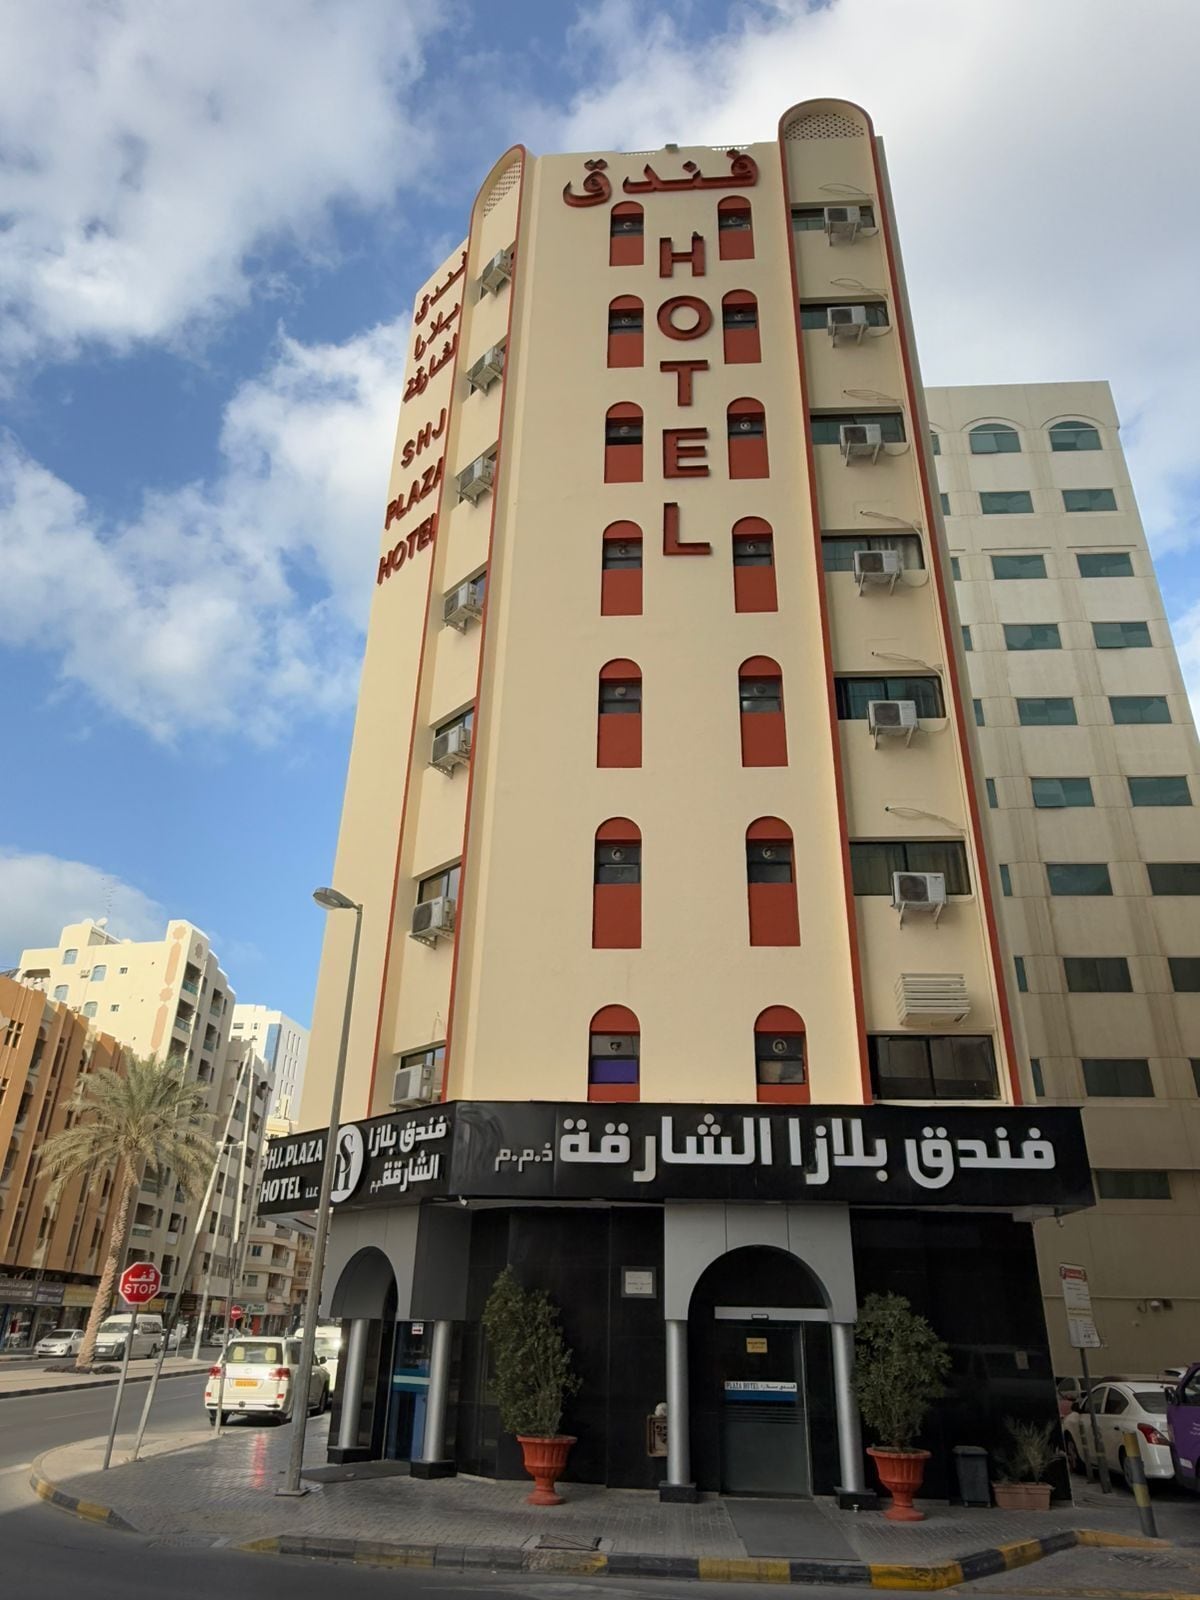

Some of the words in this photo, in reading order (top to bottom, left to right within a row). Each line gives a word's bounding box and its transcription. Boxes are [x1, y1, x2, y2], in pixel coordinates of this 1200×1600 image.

[562, 148, 759, 208] فندق
[656, 230, 714, 556] HOTEL
[400, 407, 447, 469] SHJ
[384, 456, 445, 531] PLAZA
[368, 1123, 397, 1157] بلازا
[400, 1115, 447, 1153] فندق
[559, 1112, 773, 1182] الشارقة
[788, 1117, 888, 1185] بلازا
[904, 1126, 1056, 1189] فندق
[260, 1176, 301, 1203] HOTEL
[382, 1150, 440, 1192] الشارقة
[123, 1283, 157, 1294] STOP
[128, 1269, 156, 1282] قف
